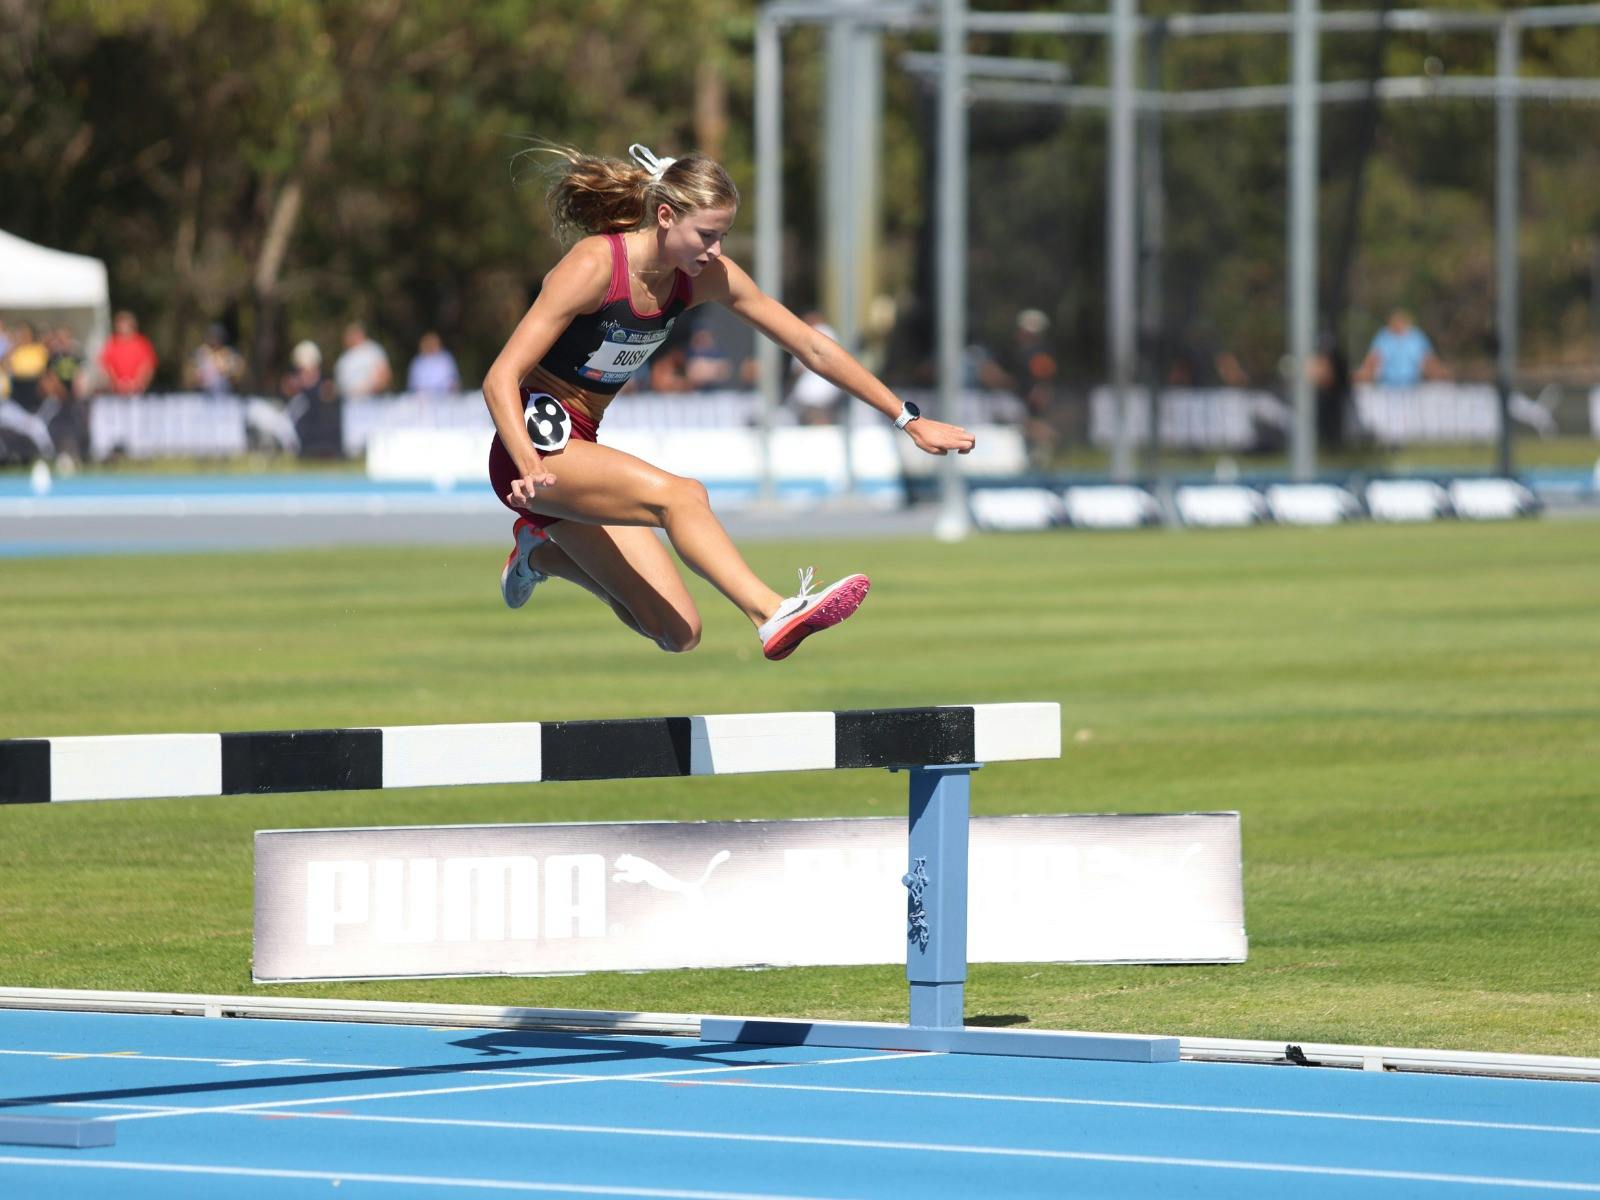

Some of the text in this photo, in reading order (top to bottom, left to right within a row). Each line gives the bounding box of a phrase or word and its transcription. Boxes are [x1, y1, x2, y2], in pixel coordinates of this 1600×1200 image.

[612, 349, 649, 366] BUSH
[526, 395, 567, 446] 8
[306, 853, 607, 946] PUMA
